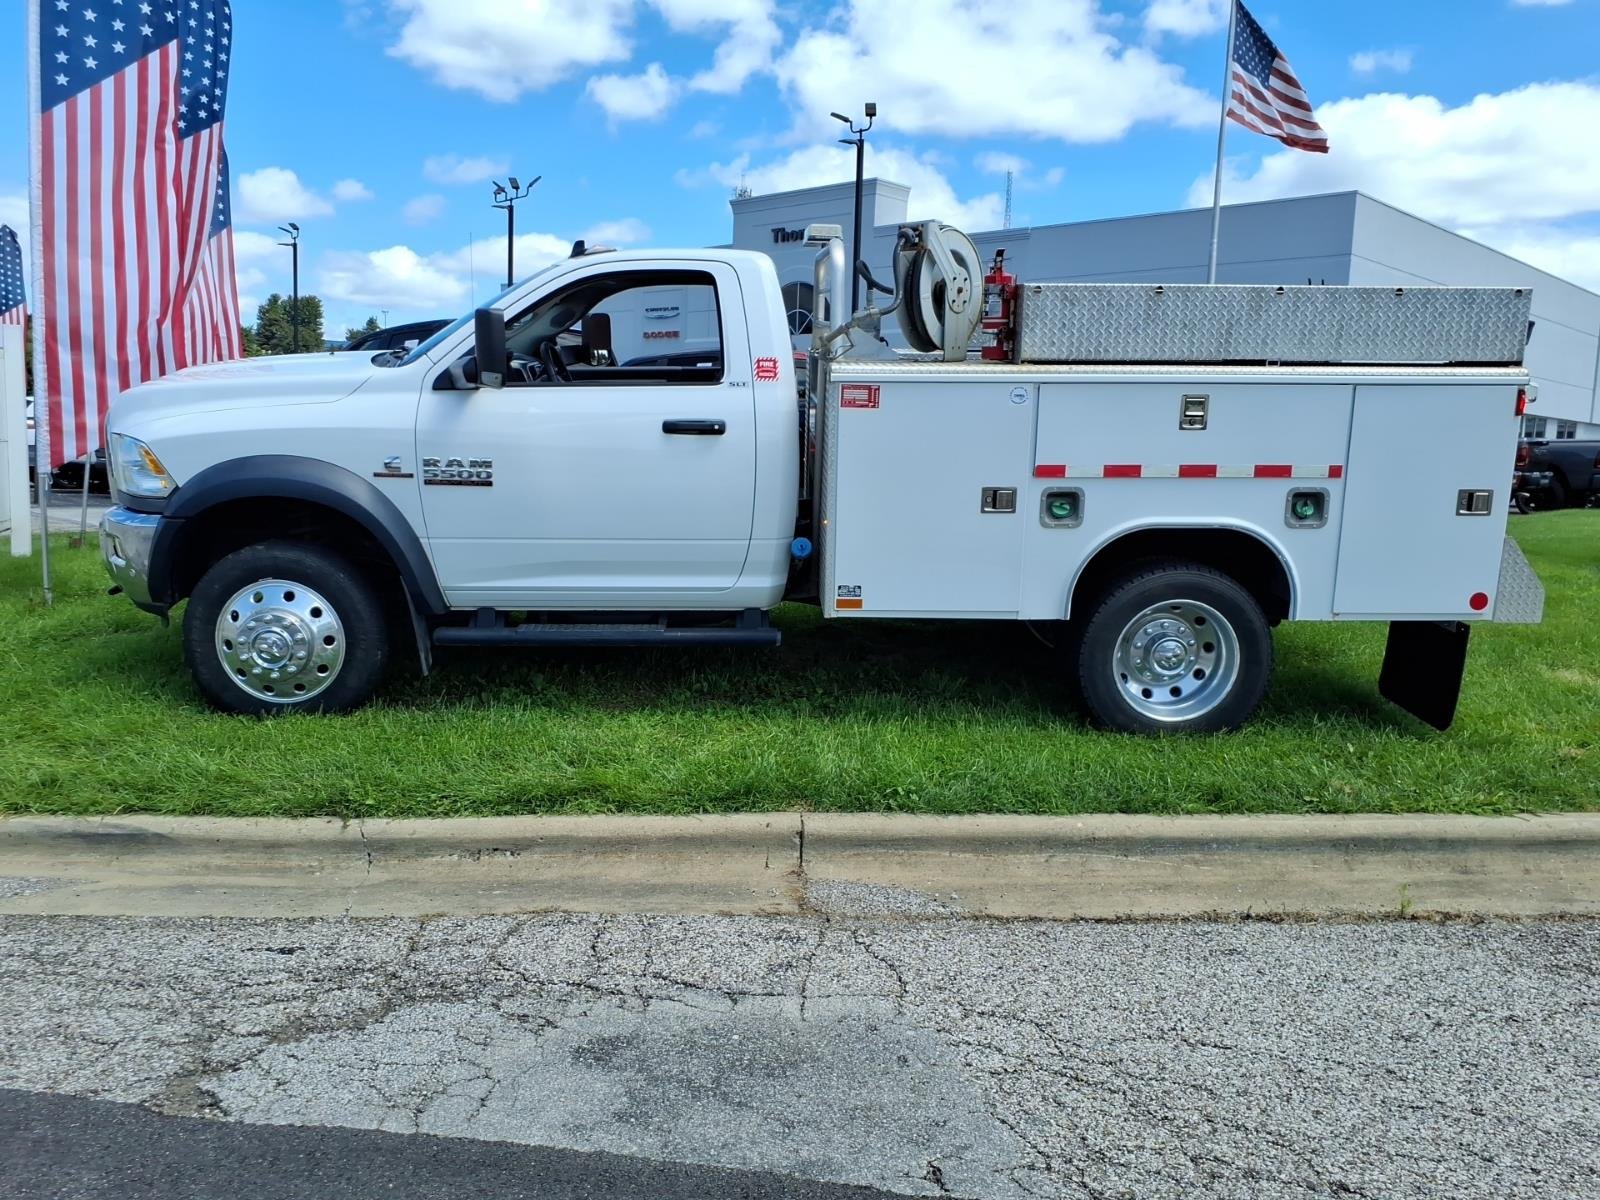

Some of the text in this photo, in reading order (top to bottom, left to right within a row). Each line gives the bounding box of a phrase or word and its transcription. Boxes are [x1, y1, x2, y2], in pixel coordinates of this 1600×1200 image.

[643, 331, 680, 339] DODGE
[423, 457, 493, 468] RAM
[423, 468, 493, 479] 5500
